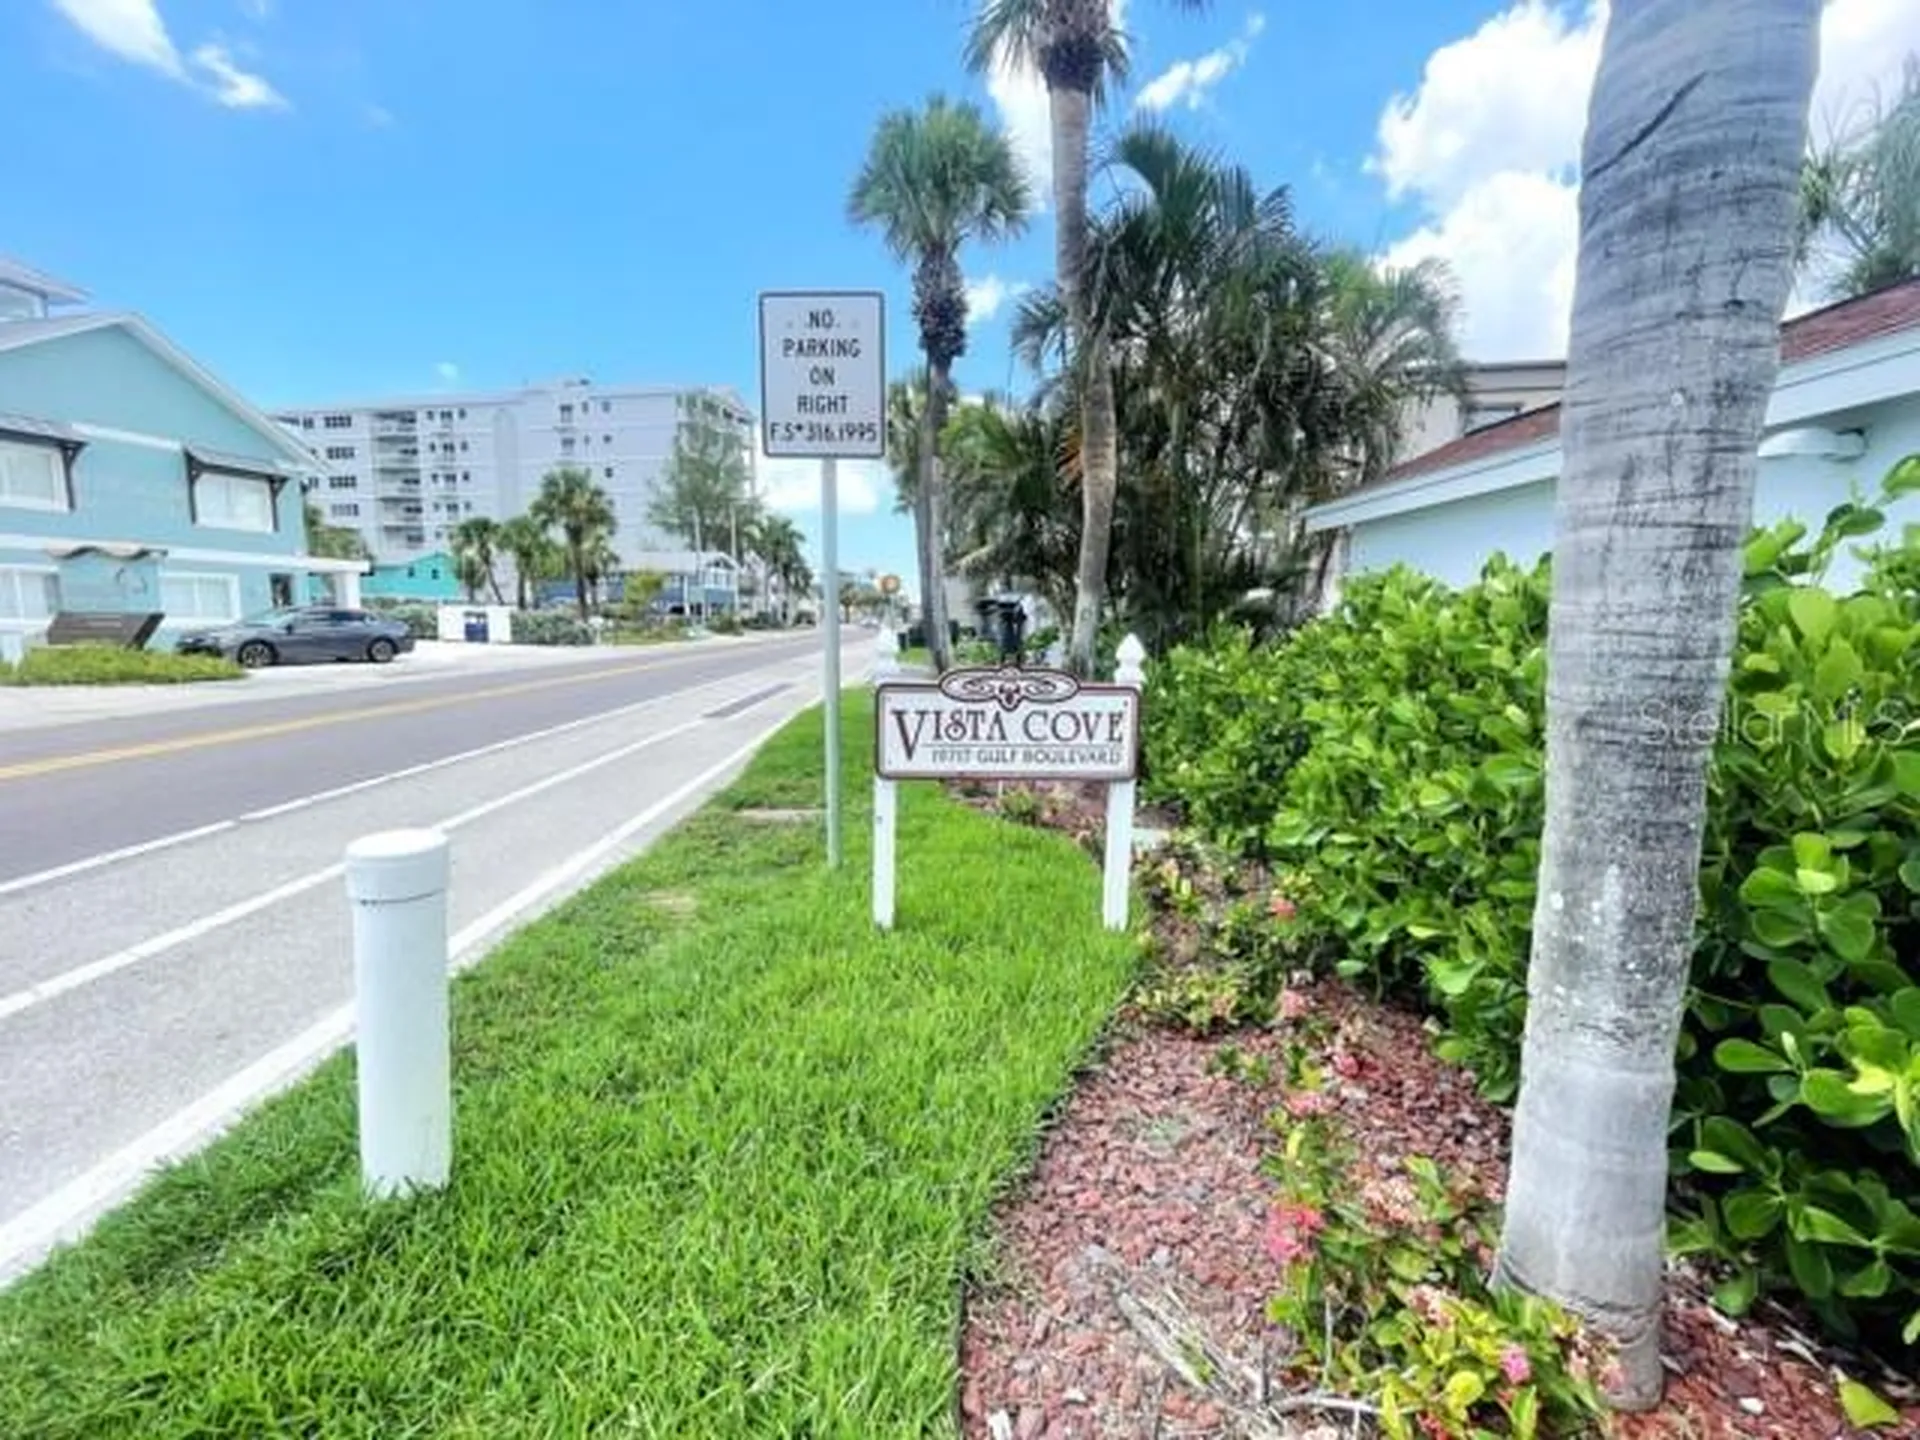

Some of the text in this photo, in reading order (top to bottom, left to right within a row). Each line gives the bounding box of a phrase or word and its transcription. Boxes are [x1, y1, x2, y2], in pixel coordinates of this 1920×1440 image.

[809, 310, 835, 331] NO
[782, 338, 862, 358] PARKING
[808, 365, 836, 386] ON
[796, 395, 849, 414] RIGHT
[891, 709, 1124, 760] VISTA COVE
[976, 749, 1016, 764] GULF
[1022, 748, 1121, 766] BOULEVARD
